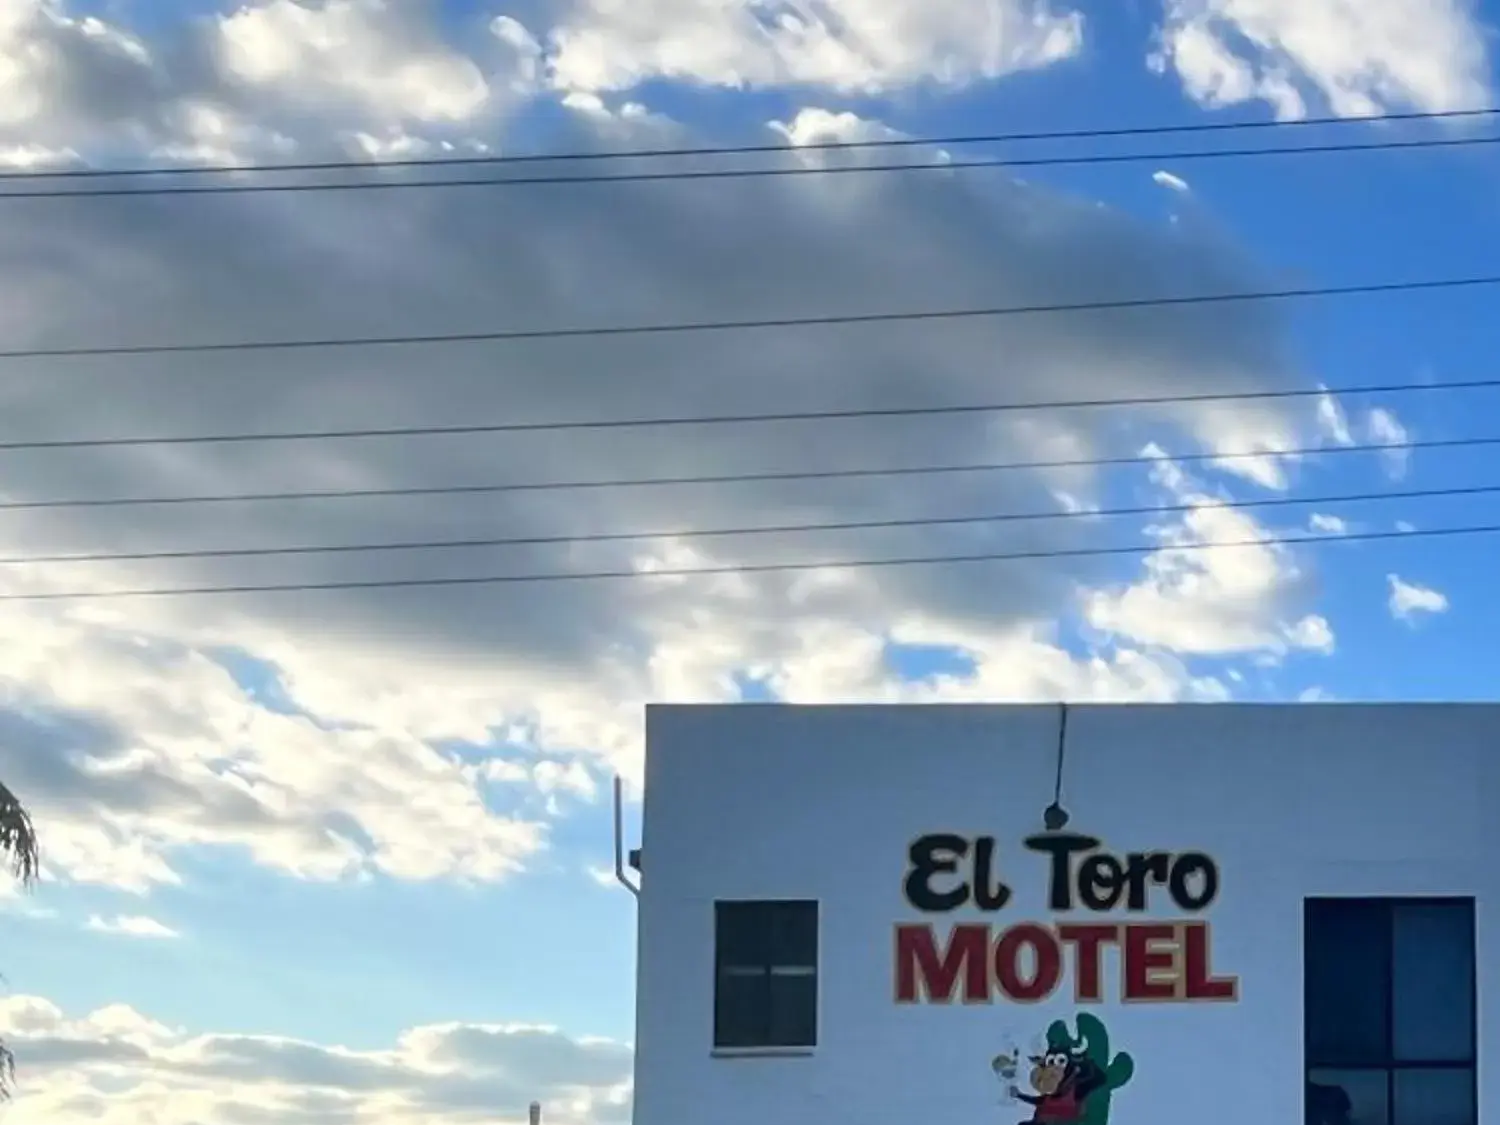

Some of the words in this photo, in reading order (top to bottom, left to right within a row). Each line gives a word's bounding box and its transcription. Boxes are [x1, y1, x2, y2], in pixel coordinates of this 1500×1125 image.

[905, 833, 1012, 912] El
[1023, 832, 1218, 911] Toro
[894, 921, 1238, 1004] MOTEL
